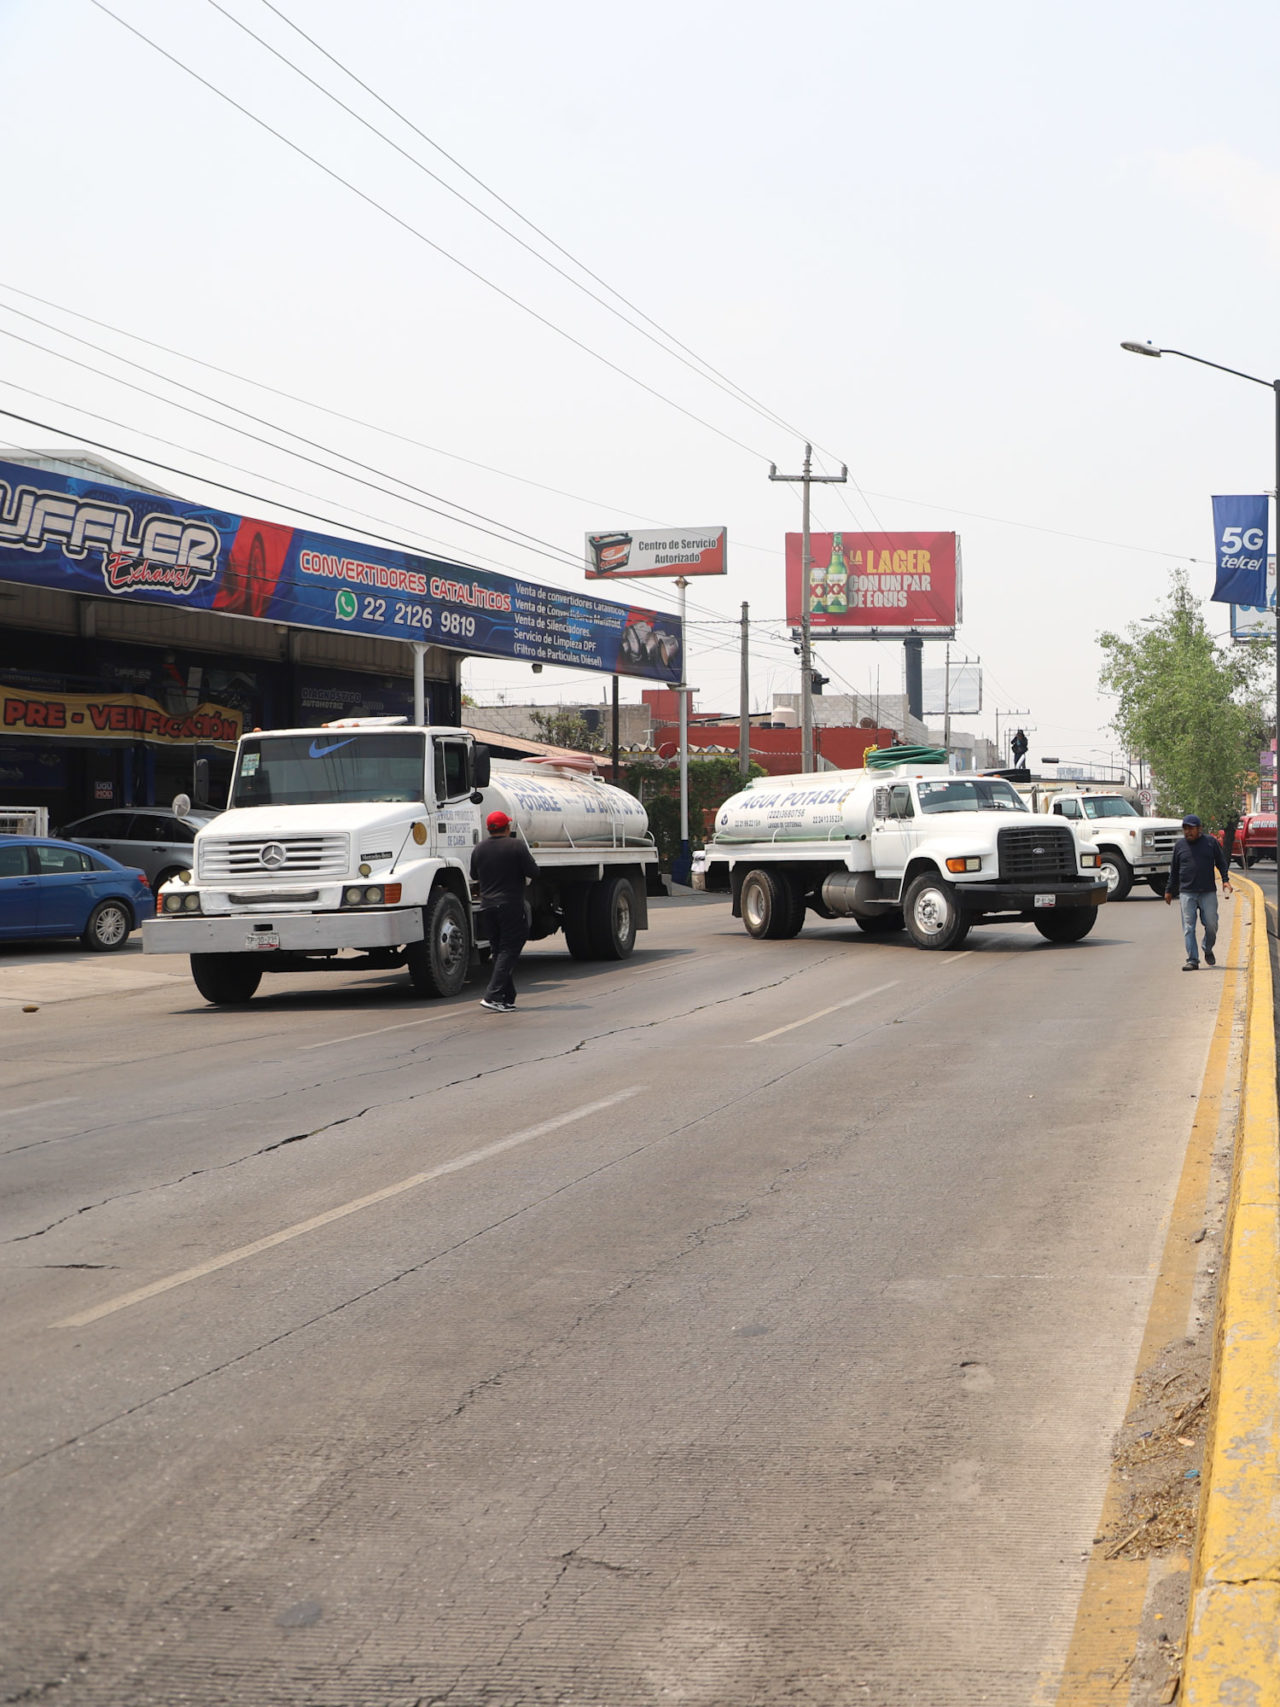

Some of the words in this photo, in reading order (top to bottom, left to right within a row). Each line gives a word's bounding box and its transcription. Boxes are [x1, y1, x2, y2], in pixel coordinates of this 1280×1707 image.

[0, 482, 218, 576] UFFLER
[1220, 527, 1264, 554] 5G
[639, 541, 666, 551] Centro
[668, 539, 680, 550] de
[681, 538, 717, 549] Servicio
[108, 550, 193, 587] Exhaust
[655, 552, 701, 564] Autorizado
[850, 550, 863, 562] LA
[867, 549, 931, 573] LAGER
[1220, 555, 1263, 571] telcel
[301, 550, 427, 597] CONVERTIDORES
[430, 577, 512, 612] CATALÍTICOS
[849, 575, 879, 591] CON
[881, 575, 901, 591] UN
[903, 575, 931, 591] PAR
[514, 598, 536, 613] Venta
[536, 603, 546, 614] de
[515, 583, 537, 598] Venta
[537, 588, 547, 600] de
[547, 592, 593, 611] convertidores
[849, 592, 865, 608] DE
[867, 592, 908, 608] EQUIS
[362, 597, 387, 622] 22
[394, 602, 433, 629] 2126
[440, 611, 476, 637] 9819
[514, 613, 536, 627] Venta
[536, 616, 546, 628] de
[546, 619, 592, 638] Silenciadores.
[513, 628, 542, 643] Servicio
[543, 633, 553, 645] de
[553, 636, 583, 651] Limpieza
[583, 640, 597, 652] DPF
[513, 642, 536, 657] (Filtro
[537, 647, 546, 658] de
[4, 700, 66, 728] PRE
[739, 794, 781, 810] AGUA
[780, 788, 852, 807] POTABLE
